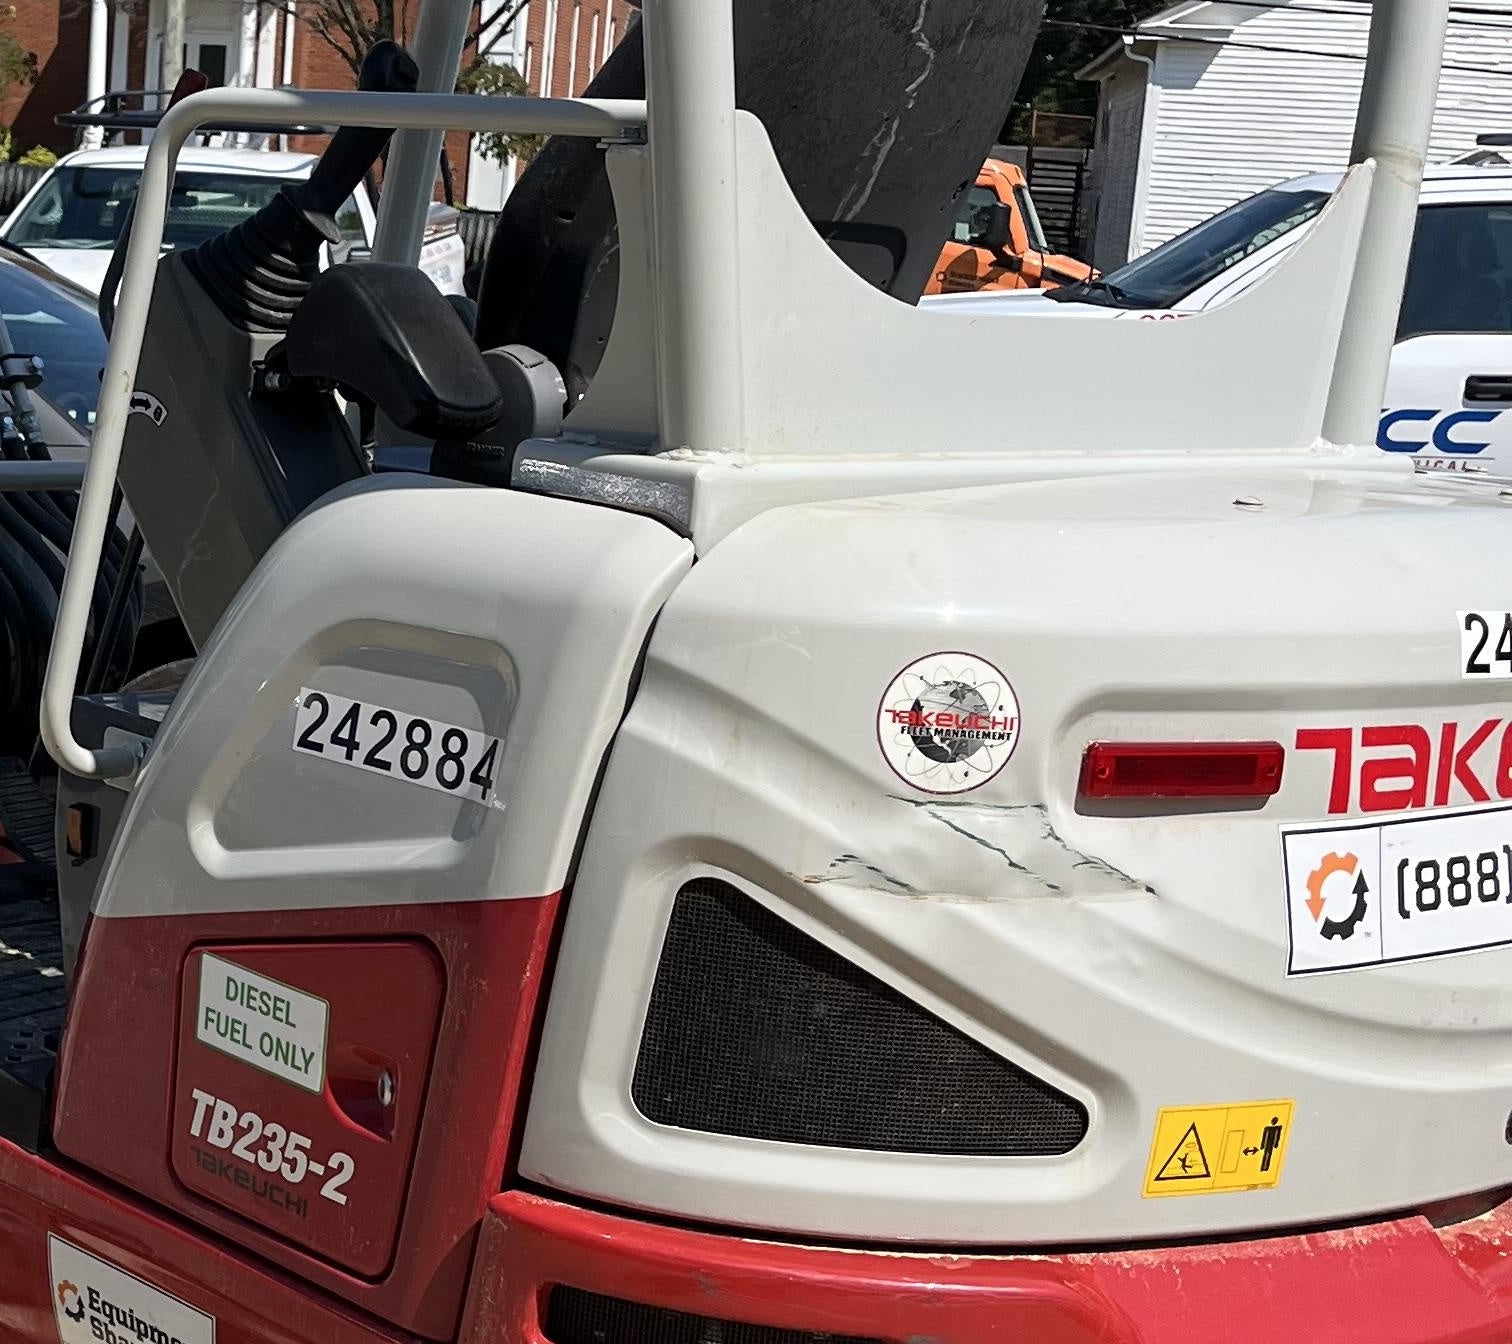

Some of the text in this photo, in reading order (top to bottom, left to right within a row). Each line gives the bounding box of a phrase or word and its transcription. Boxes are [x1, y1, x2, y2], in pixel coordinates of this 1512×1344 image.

[296, 692, 499, 801] 242884
[900, 725, 1013, 741] FLEET MANAGEMENT
[225, 975, 297, 1029] DIESEL
[203, 1006, 316, 1075] FUEL ONLY
[189, 1087, 356, 1206] TB235-2
